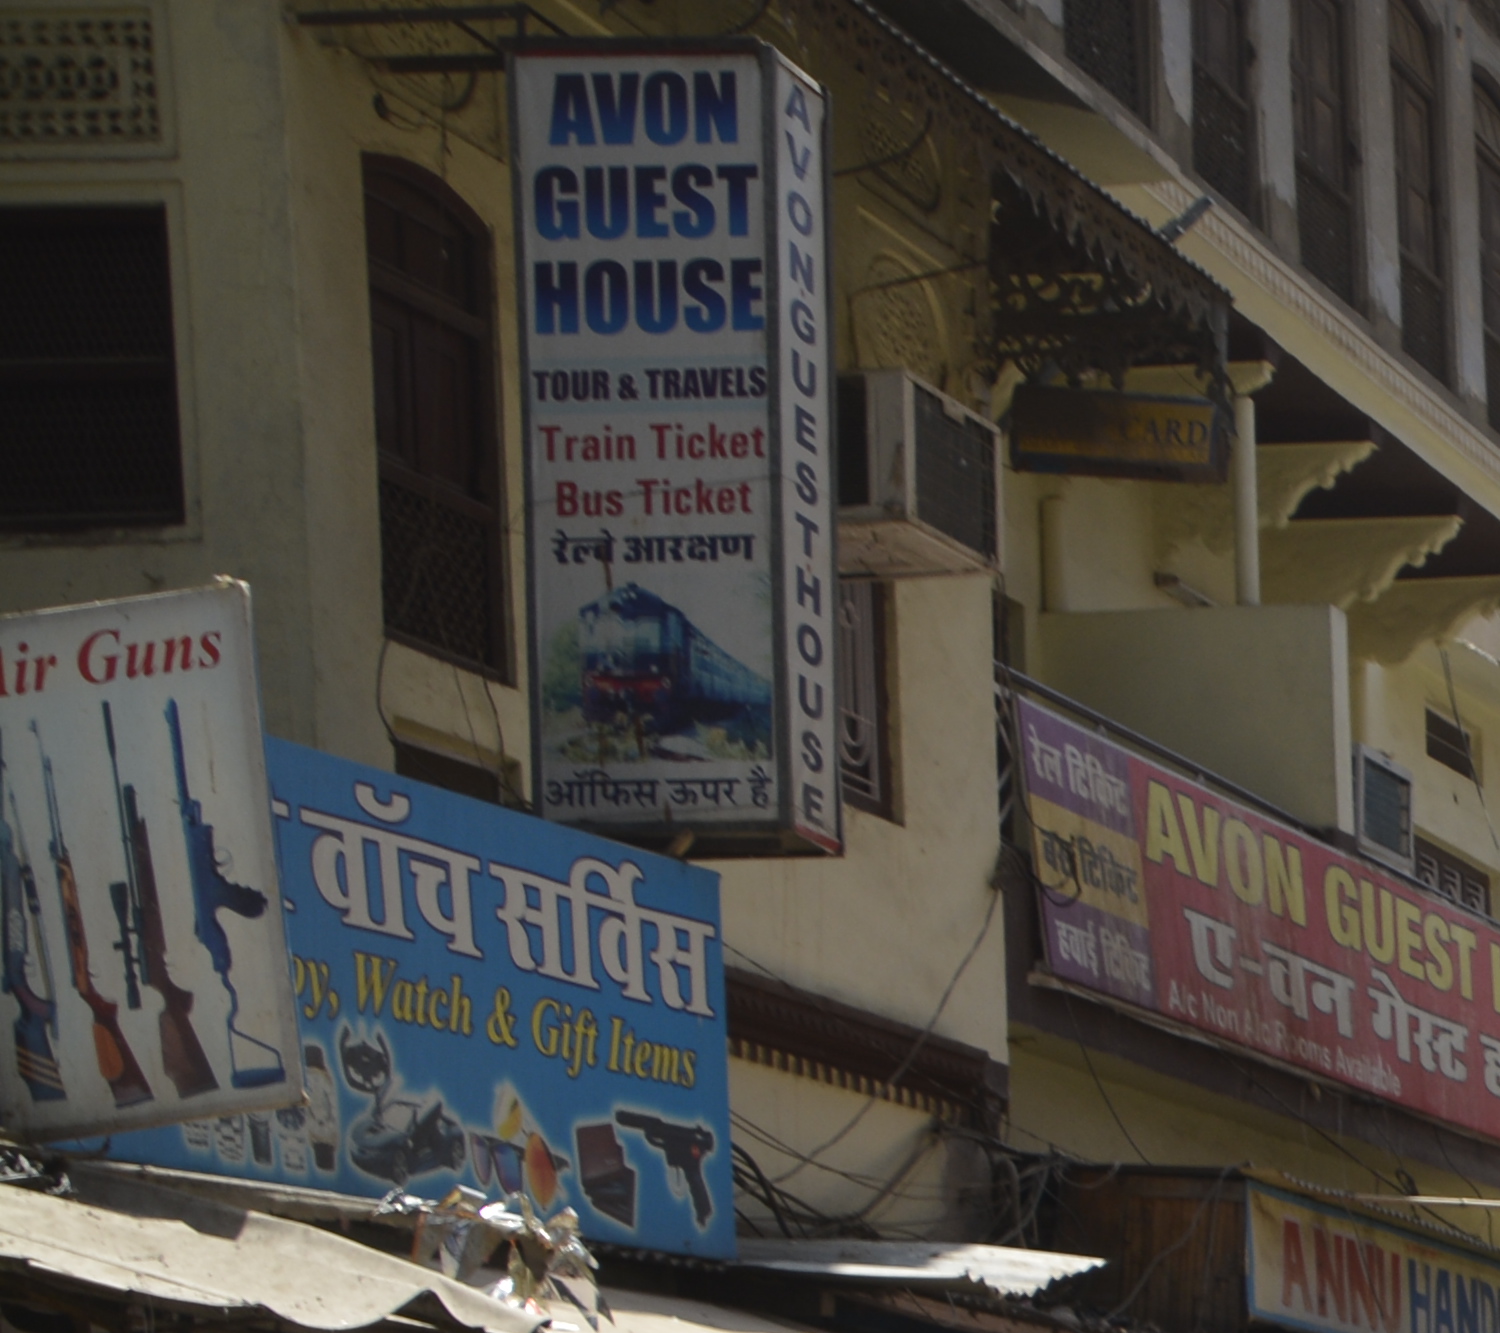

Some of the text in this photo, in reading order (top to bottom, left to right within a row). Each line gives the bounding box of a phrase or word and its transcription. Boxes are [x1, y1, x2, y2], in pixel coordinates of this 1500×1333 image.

[548, 69, 739, 146] AVON
[534, 162, 758, 241] GUEST
[533, 257, 766, 335] HOUSE
[533, 365, 768, 401] TOUR & TRAVELS
[538, 421, 767, 462] Train Ticket
[555, 477, 754, 518] Bus Ticket
[623, 532, 756, 564] आरक्षण
[77, 626, 222, 686] Guns
[544, 764, 774, 810] ऑफिस ऊपर है
[299, 782, 485, 959] वॉच
[487, 855, 717, 1018] सर्विस
[1145, 778, 1307, 930] AVON
[1323, 864, 1478, 1001] GUEST
[352, 951, 474, 1037] Watch
[486, 985, 520, 1048] &
[531, 996, 599, 1080] Gift
[605, 1014, 697, 1090] Items
[1367, 966, 1470, 1082] गेस्ट
